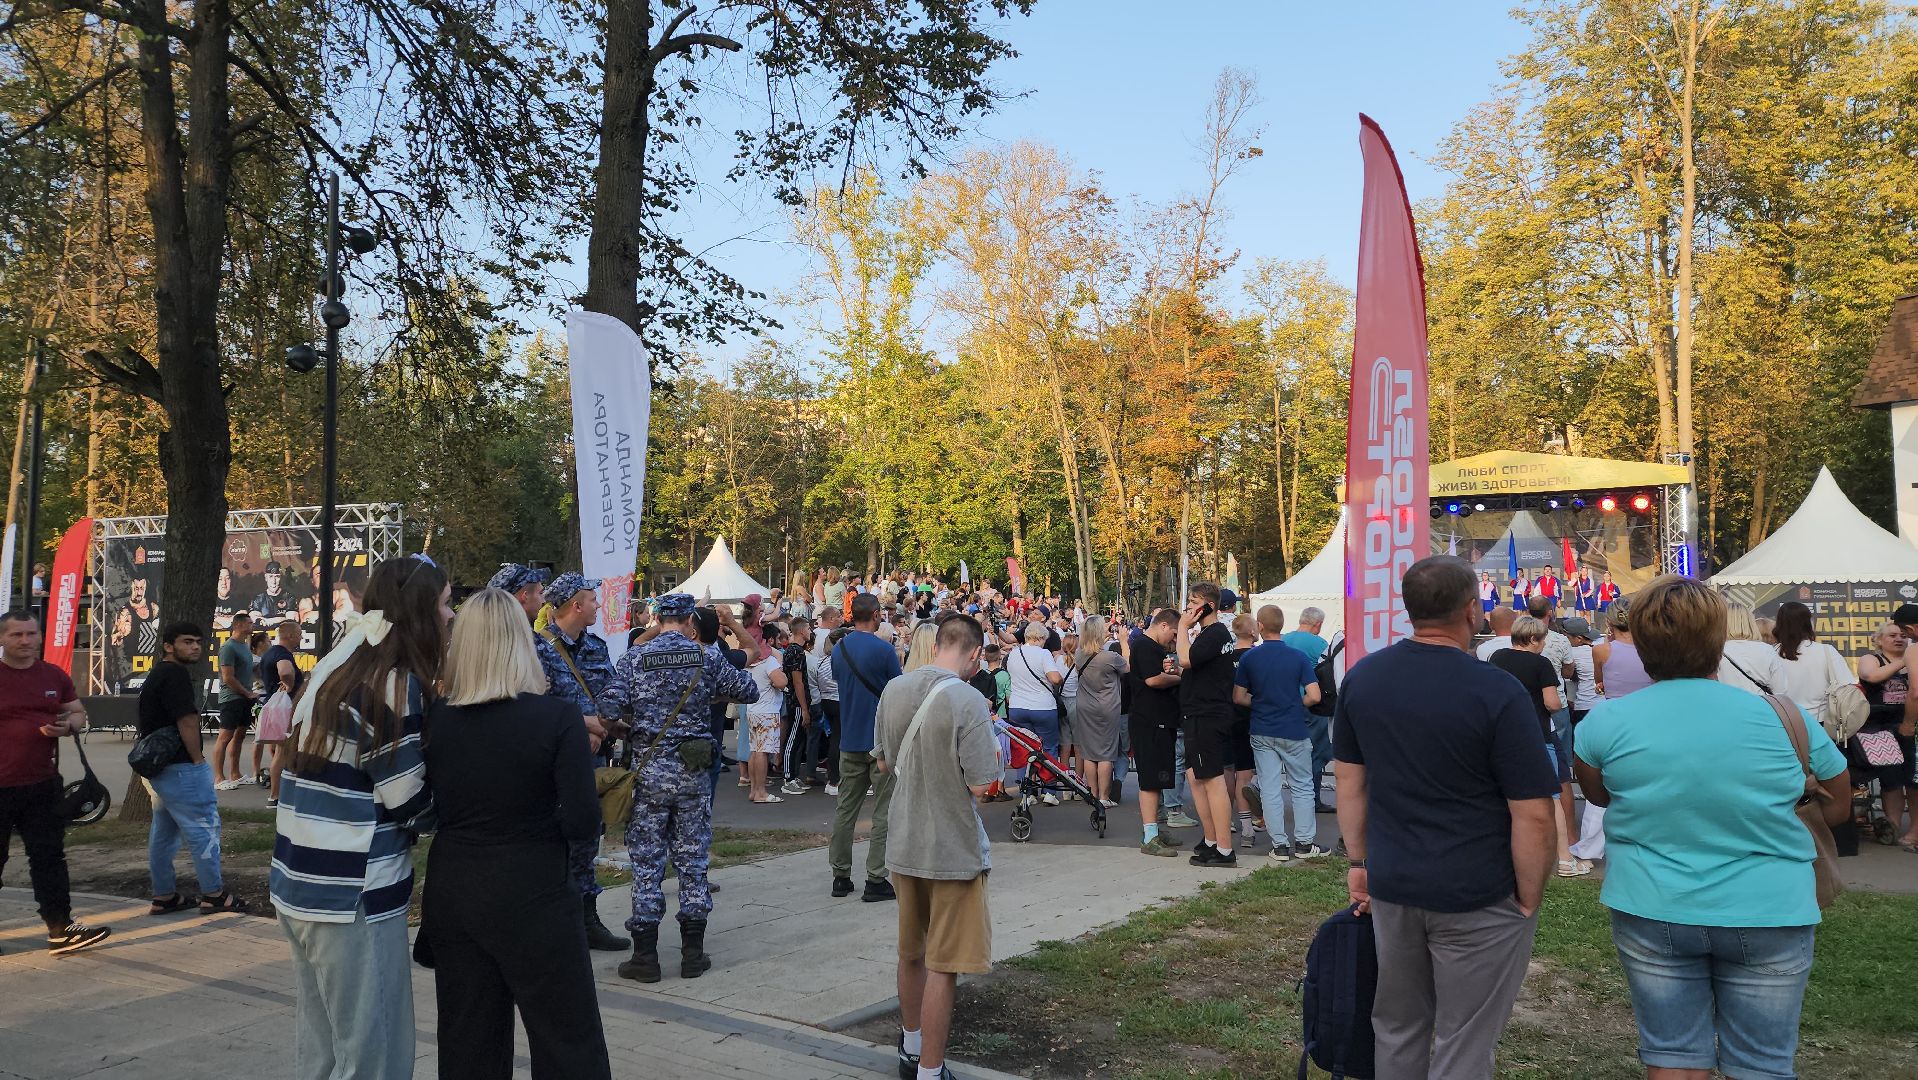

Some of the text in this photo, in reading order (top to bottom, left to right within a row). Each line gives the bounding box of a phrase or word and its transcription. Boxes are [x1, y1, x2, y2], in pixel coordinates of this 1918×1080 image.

[1457, 463, 1549, 478] ЛЮБИ СПОРТ,
[1437, 476, 1571, 492] ЖИВИ ЗДОРОВЬЕМ!
[645, 652, 701, 667] РОСГВАРДИЯ
